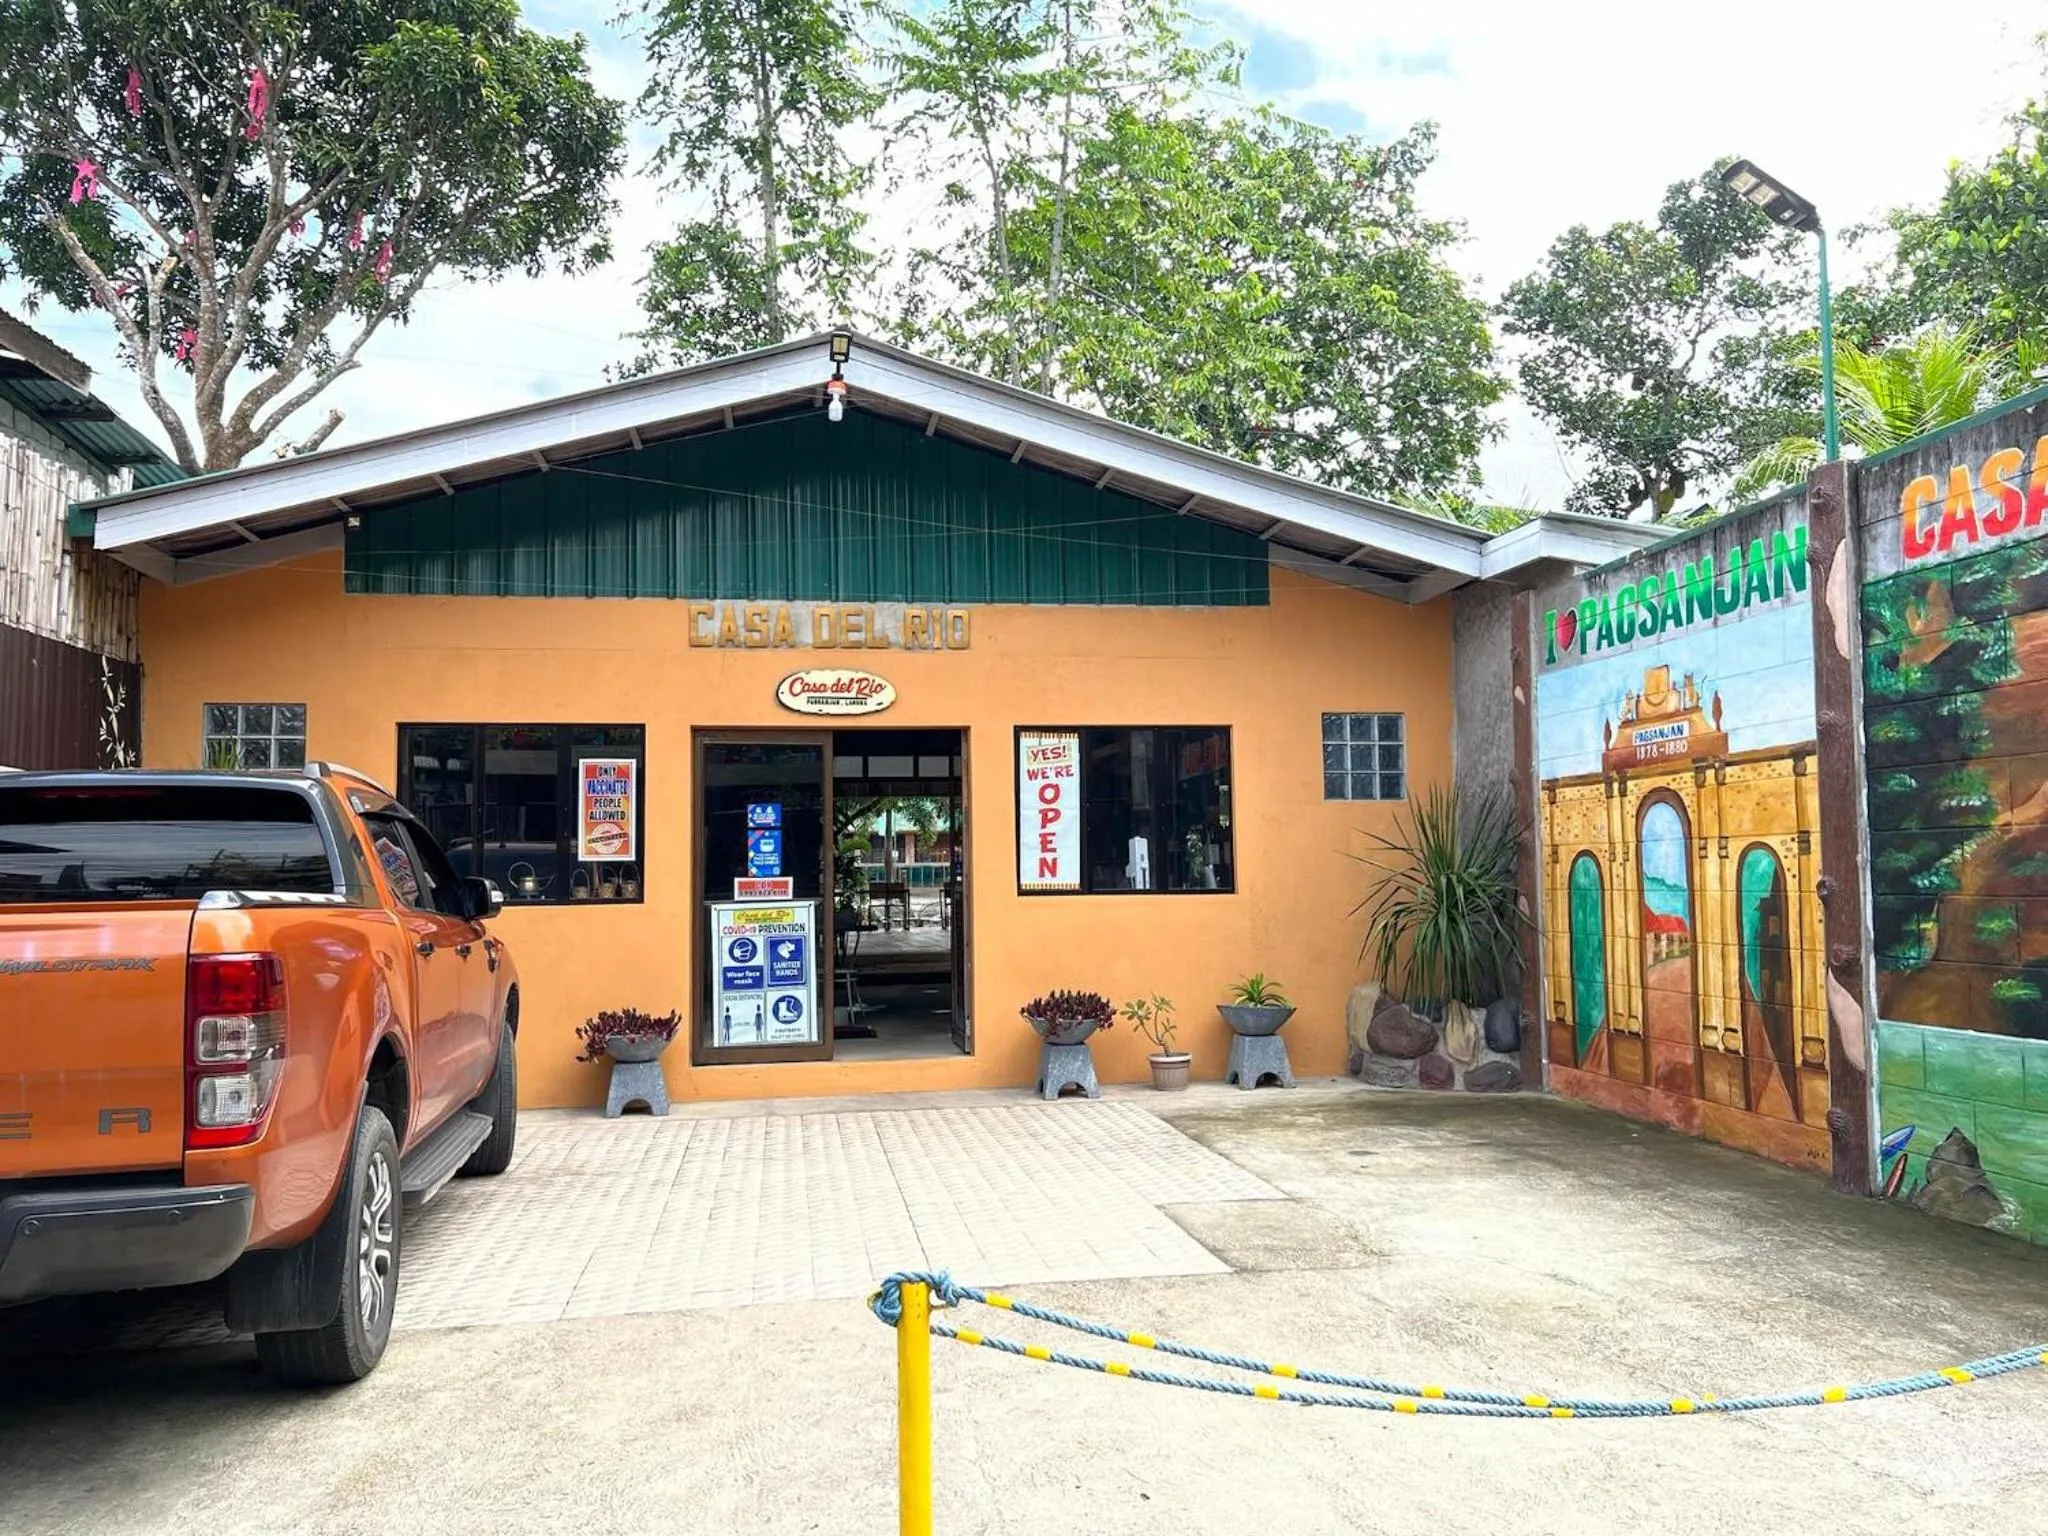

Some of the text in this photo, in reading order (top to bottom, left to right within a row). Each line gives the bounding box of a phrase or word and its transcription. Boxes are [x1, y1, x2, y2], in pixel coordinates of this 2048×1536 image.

[1544, 523, 1810, 665] I PAGSANJAN
[688, 604, 971, 650] CASA DEL RIO
[789, 677, 887, 698] Casa del Rio
[1635, 724, 1685, 743] PAGSANJAN
[1031, 745, 1067, 762] YES!
[1027, 765, 1074, 781] WE'RE
[593, 798, 622, 807] PEOPLE
[589, 810, 626, 820] ALLOWED
[1038, 783, 1061, 878] OPEN
[722, 923, 806, 934] COVID-19 PREVENTION
